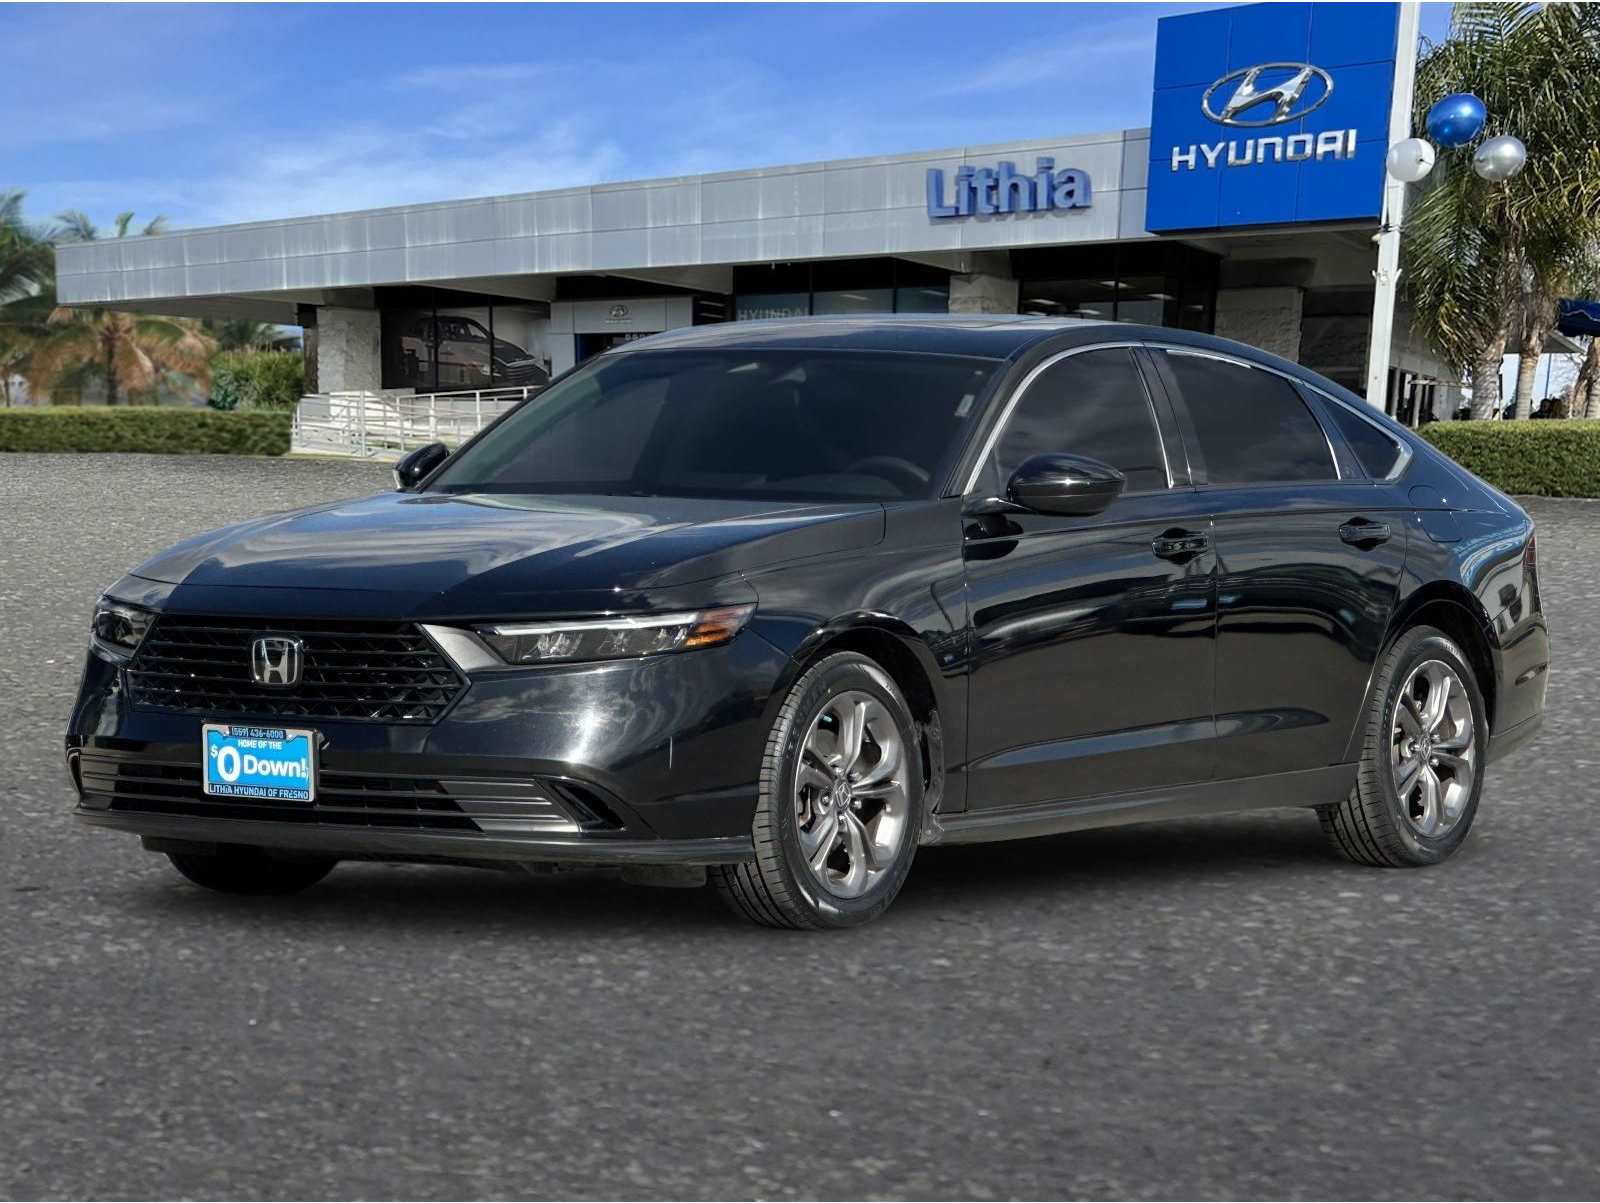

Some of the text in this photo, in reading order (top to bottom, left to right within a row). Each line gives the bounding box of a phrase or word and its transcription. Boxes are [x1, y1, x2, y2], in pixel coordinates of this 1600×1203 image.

[1171, 129, 1358, 171] HYUNDAI
[926, 156, 1092, 219] Lithia
[238, 740, 282, 750] HOME OF THE
[243, 754, 309, 779] Down!
[209, 784, 309, 800] LITHIA HYUNDAI OF FRESNO
